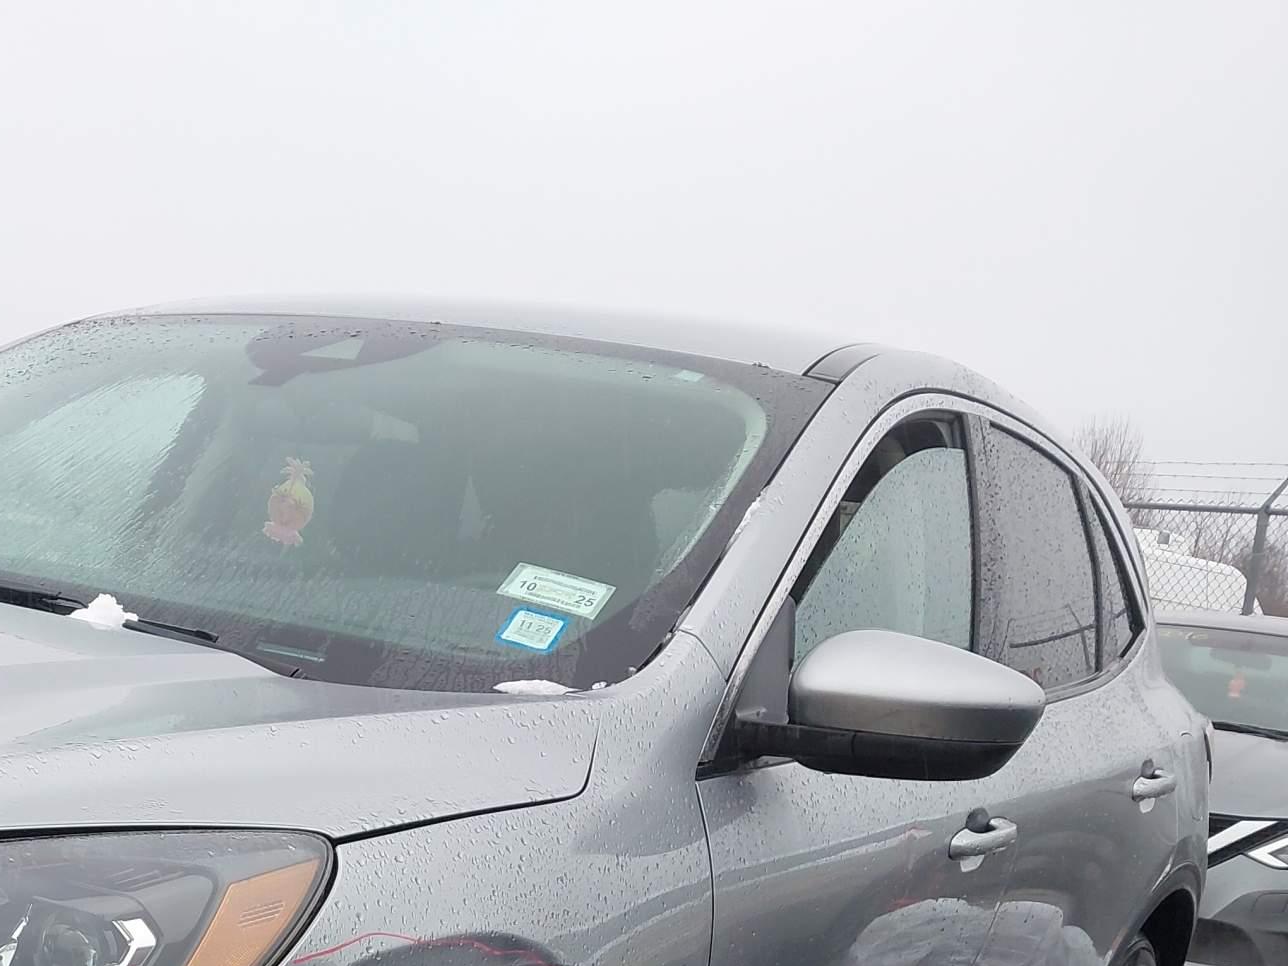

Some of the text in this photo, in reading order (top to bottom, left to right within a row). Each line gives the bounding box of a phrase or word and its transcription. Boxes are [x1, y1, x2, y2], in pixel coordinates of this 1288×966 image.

[520, 580, 537, 592] 10
[574, 595, 596, 607] 25
[519, 619, 552, 635] 11 25
